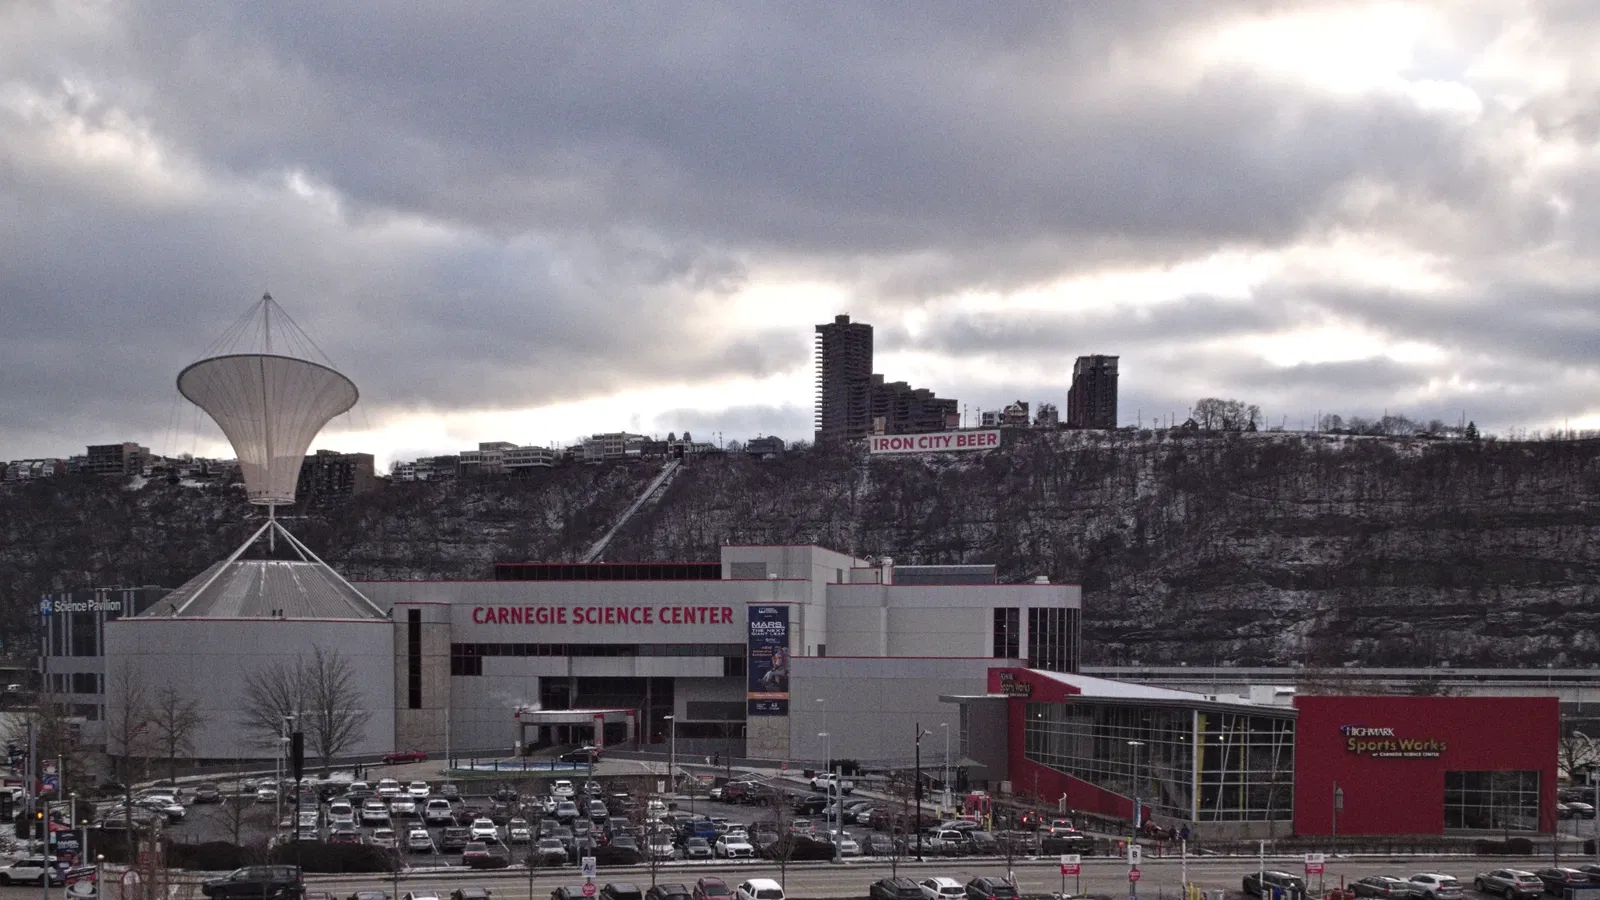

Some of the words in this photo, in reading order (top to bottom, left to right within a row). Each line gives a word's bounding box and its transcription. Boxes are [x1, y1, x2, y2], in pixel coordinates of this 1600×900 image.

[874, 437, 913, 450] IRON
[918, 436, 952, 449] CITY
[956, 434, 997, 447] BEER
[54, 600, 87, 612] Science
[88, 599, 121, 611] Pavilion
[472, 606, 566, 625] CARNEGIE
[572, 606, 653, 625] SCIENCE
[659, 606, 733, 625] CENTER
[1346, 727, 1395, 737] HIGHMARK
